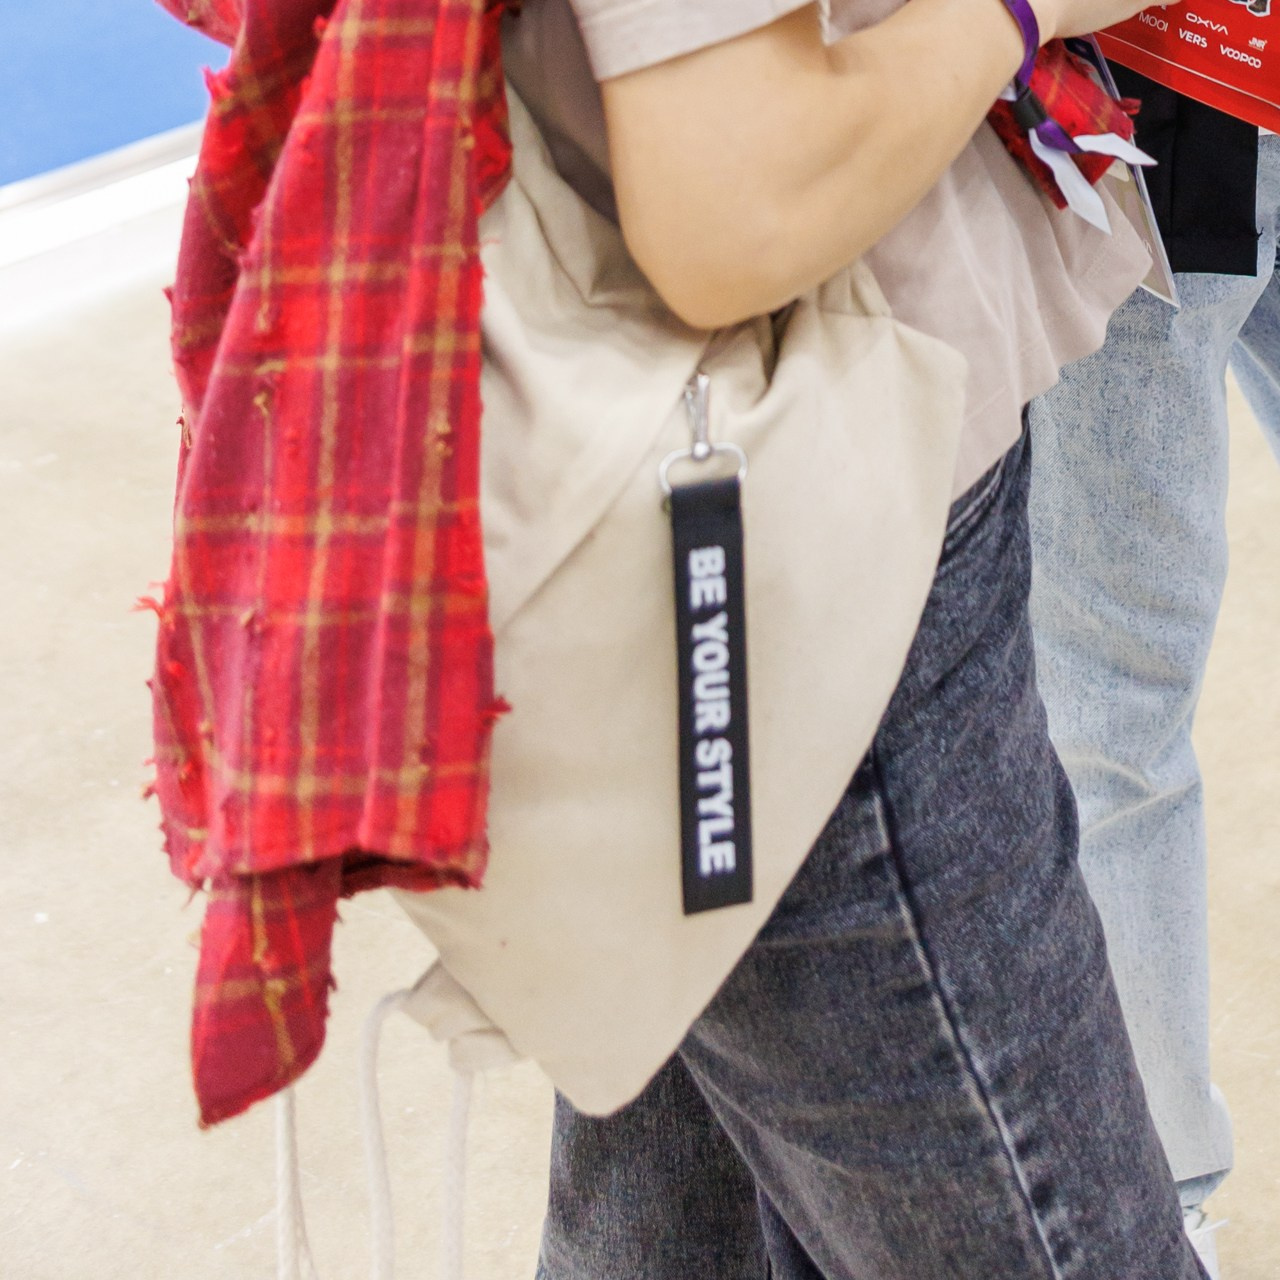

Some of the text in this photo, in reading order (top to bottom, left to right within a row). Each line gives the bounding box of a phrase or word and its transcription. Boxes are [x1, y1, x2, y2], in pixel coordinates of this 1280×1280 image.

[1139, 11, 1168, 32] MOOI
[1185, 12, 1228, 35] OXVA
[1179, 28, 1207, 48] VERS
[1220, 44, 1262, 68] VOOPOO
[688, 546, 736, 876] BE YOUR STYLE
